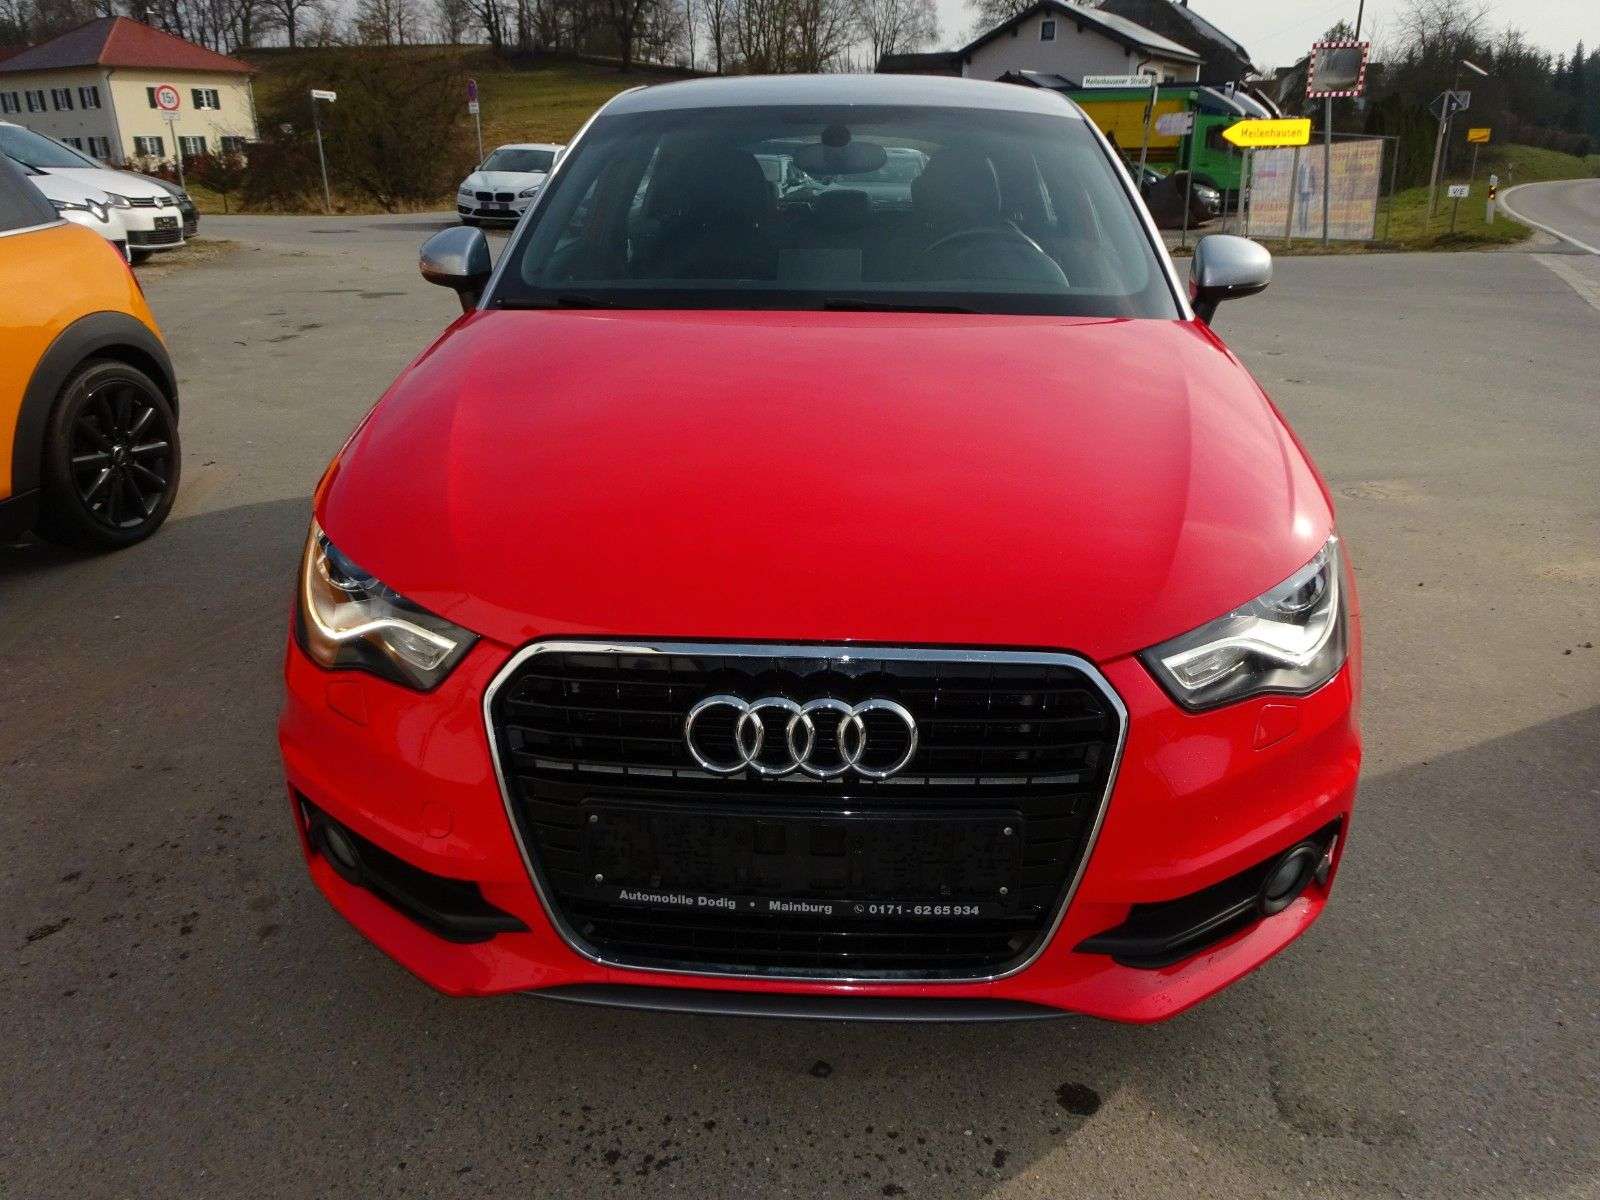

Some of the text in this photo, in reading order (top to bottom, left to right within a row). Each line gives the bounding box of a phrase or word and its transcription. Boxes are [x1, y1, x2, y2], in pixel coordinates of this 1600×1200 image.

[619, 889, 693, 905] Automobile
[697, 896, 736, 910] Dodig
[769, 900, 833, 915] Mainburg
